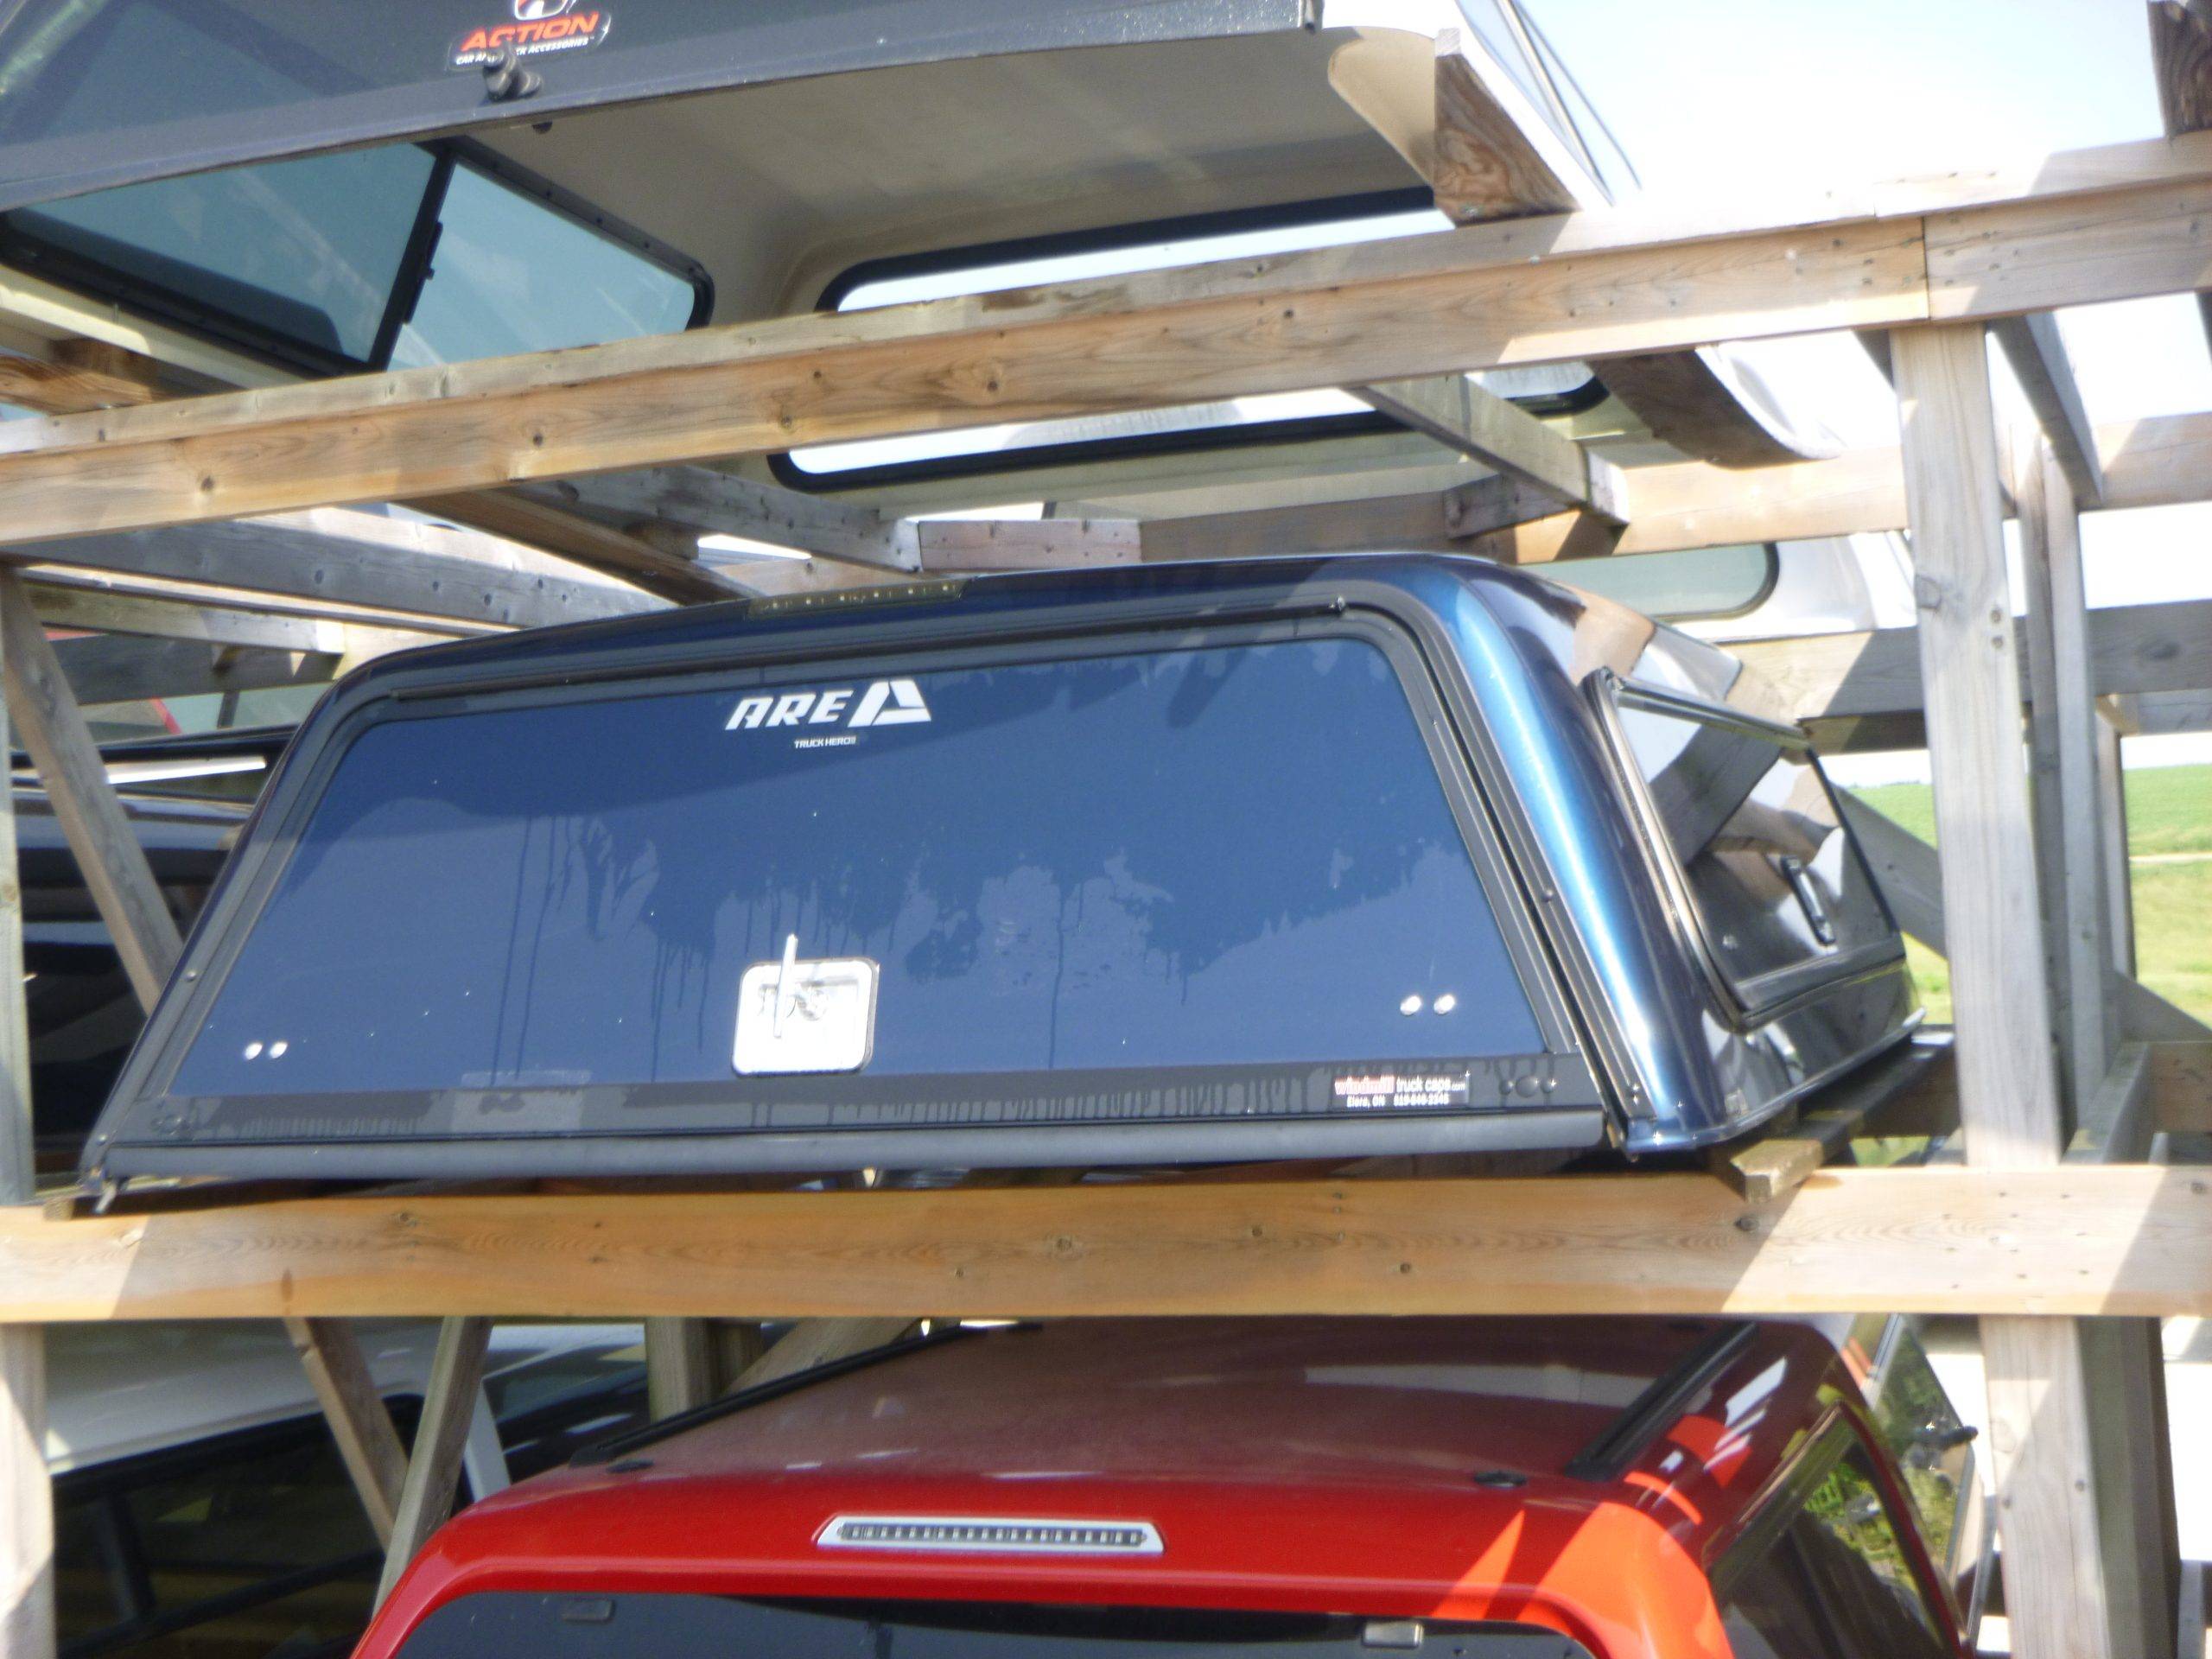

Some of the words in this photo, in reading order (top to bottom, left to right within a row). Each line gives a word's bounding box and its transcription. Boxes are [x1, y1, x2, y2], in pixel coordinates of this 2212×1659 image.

[460, 10, 600, 53] ACTION
[724, 690, 855, 731] ARE
[794, 737, 824, 749] TRUCK
[1334, 1075, 1395, 1095] windmill
[1396, 1075, 1423, 1092] truck
